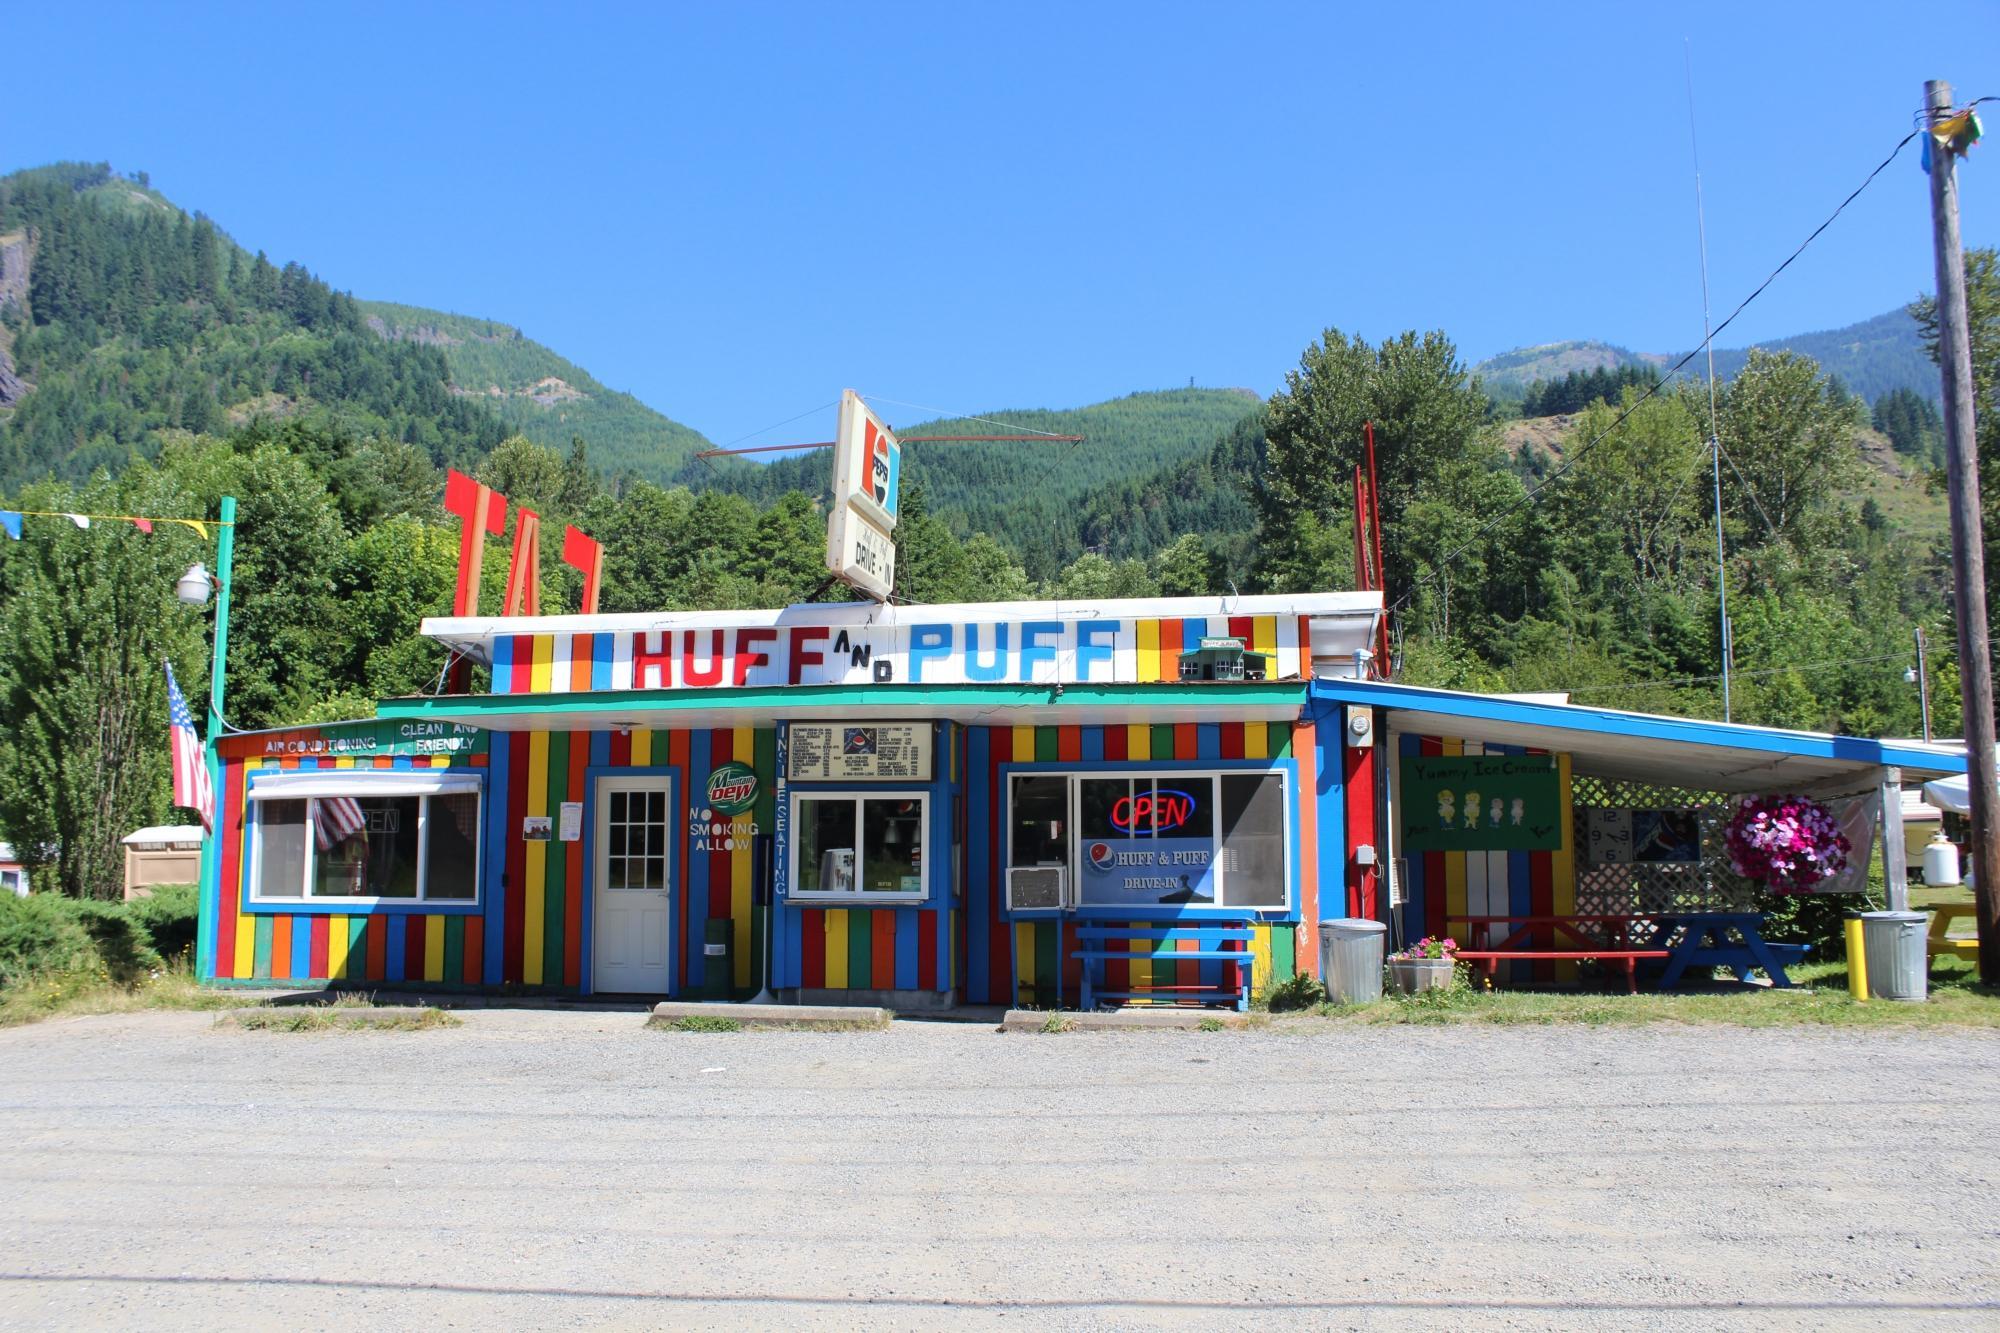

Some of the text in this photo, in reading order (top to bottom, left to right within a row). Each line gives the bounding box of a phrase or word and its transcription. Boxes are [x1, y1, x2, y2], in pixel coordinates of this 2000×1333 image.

[873, 454, 888, 483] PEPSI
[856, 541, 876, 575] DRIVE
[634, 620, 1120, 688] HUFF AND PUFF
[401, 724, 479, 736] CLEAN AND
[266, 737, 376, 752] AIR CONDITIONING
[416, 738, 475, 750] FRIENDLY
[1415, 761, 1552, 780] Yummy Ice Cream
[690, 807, 712, 821] NO
[1112, 797, 1188, 826] OPEN
[1603, 811, 1617, 822] 12
[690, 823, 759, 836] SMOKING
[1591, 830, 1602, 841] 9
[1620, 830, 1629, 841] 3
[696, 838, 749, 851] ALLOW
[775, 806, 787, 895] SEATING
[1117, 851, 1209, 866] HUFF & PUFF
[1606, 849, 1616, 860] 6
[1123, 877, 1178, 889] DRIVE-IN
